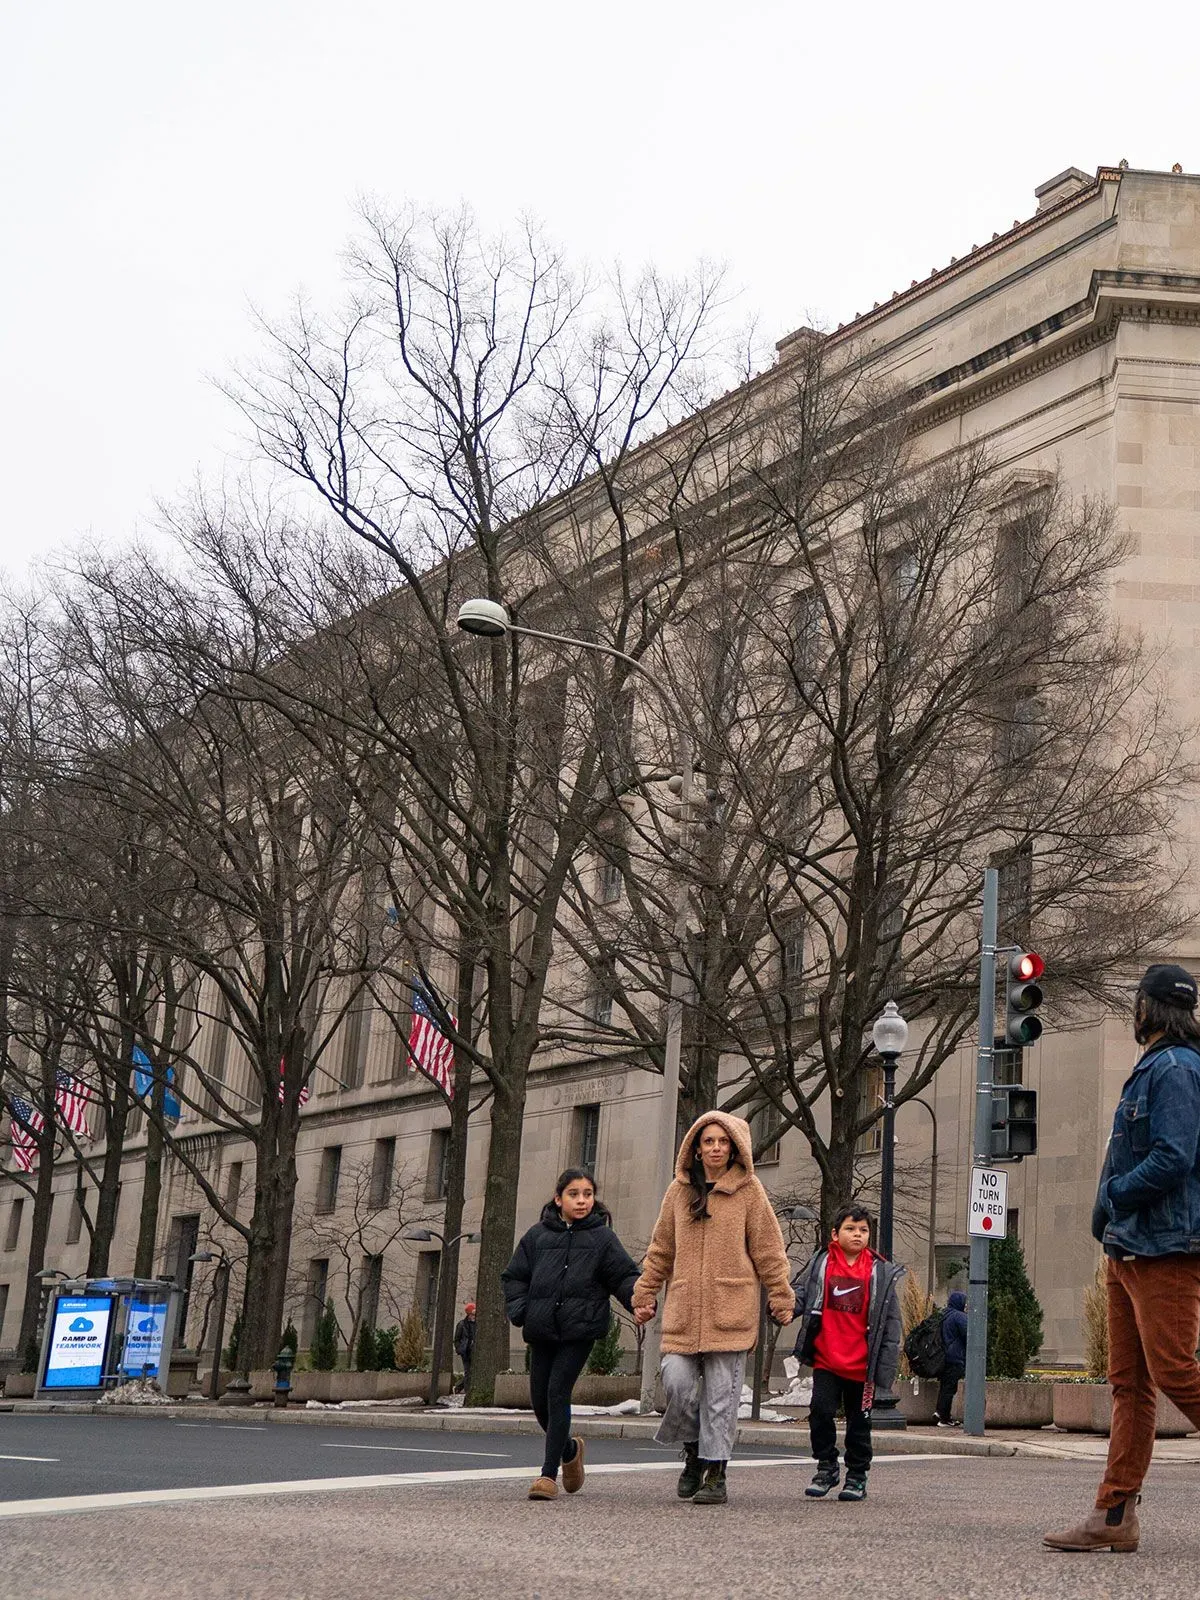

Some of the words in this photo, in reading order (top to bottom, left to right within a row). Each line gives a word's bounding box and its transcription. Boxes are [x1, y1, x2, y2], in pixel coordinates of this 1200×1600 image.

[981, 1173, 998, 1187] NO
[978, 1188, 1000, 1201] TURN
[972, 1201, 985, 1213] ON
[987, 1203, 1004, 1216] RED
